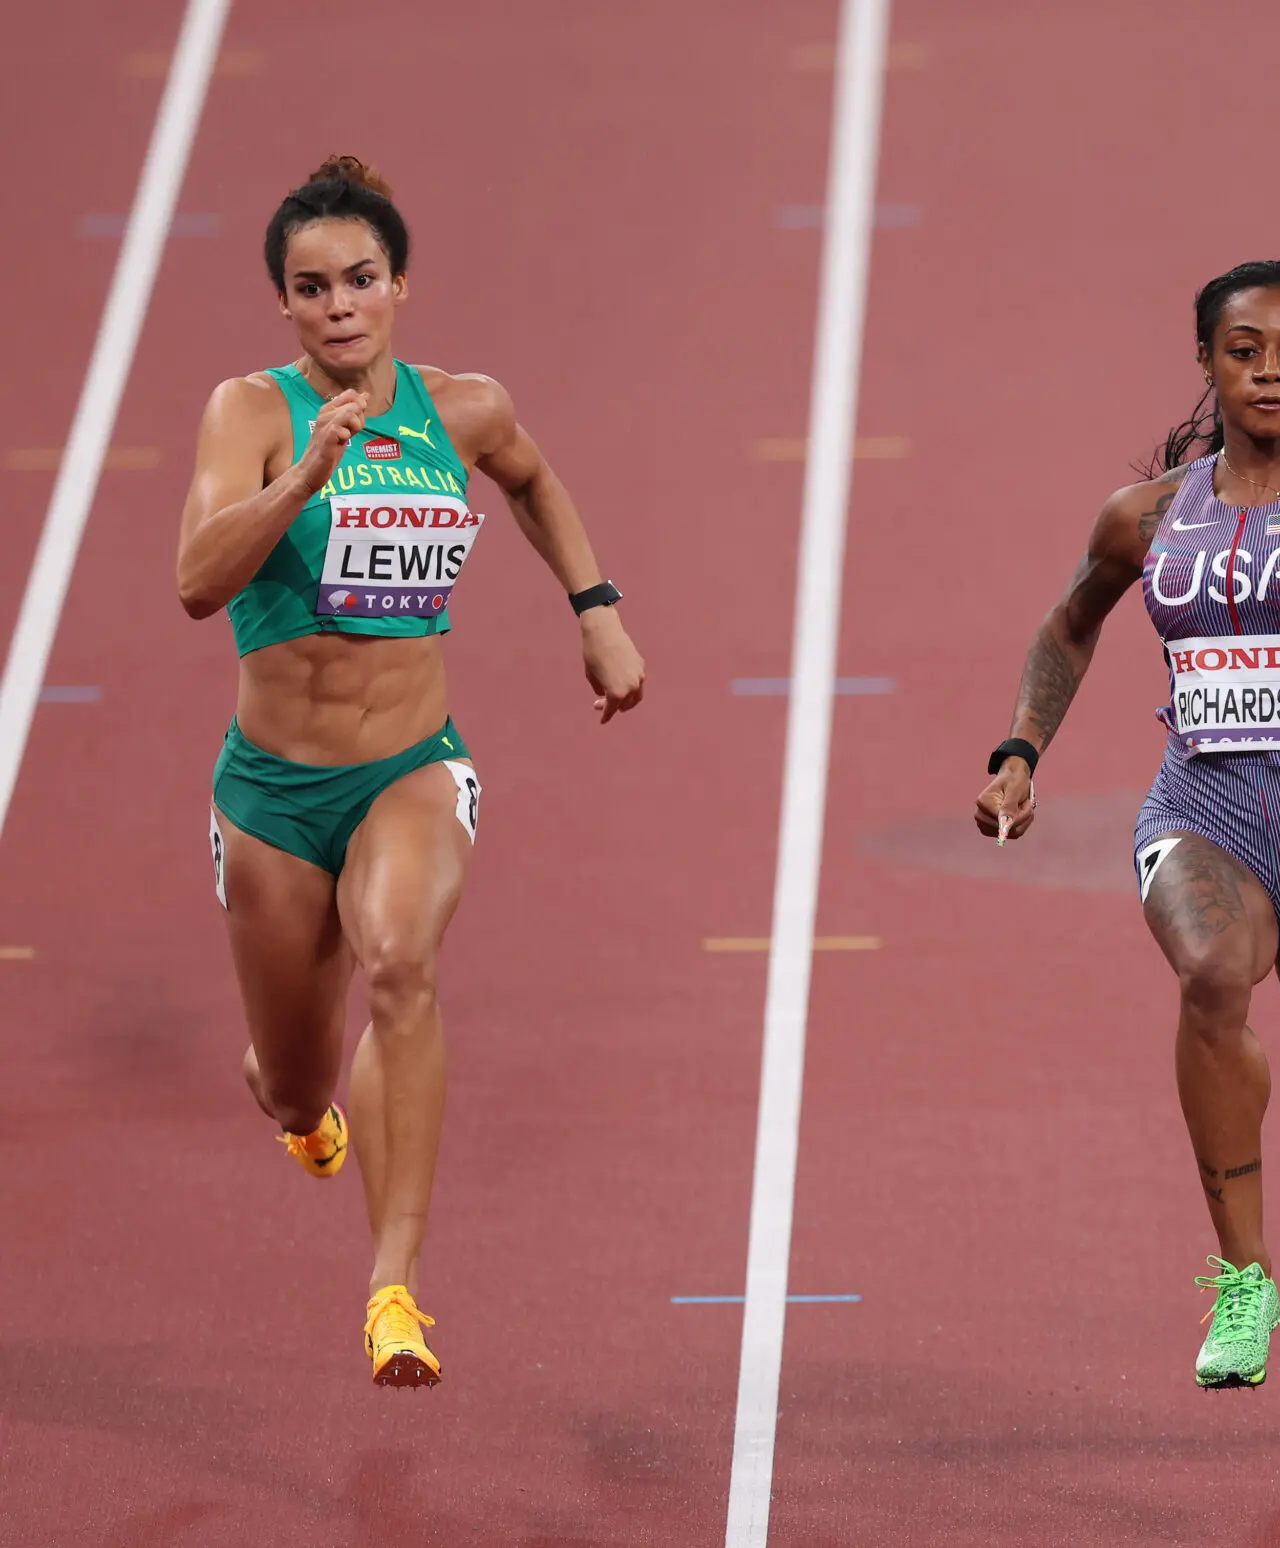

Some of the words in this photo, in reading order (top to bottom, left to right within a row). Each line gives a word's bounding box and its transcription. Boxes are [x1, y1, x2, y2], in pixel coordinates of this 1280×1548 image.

[366, 444, 398, 454] CHEMIST
[320, 464, 463, 500] AUSTRALIA
[336, 507, 479, 528] HONDA
[340, 545, 466, 580] LEWIS
[1143, 849, 1161, 889] 7
